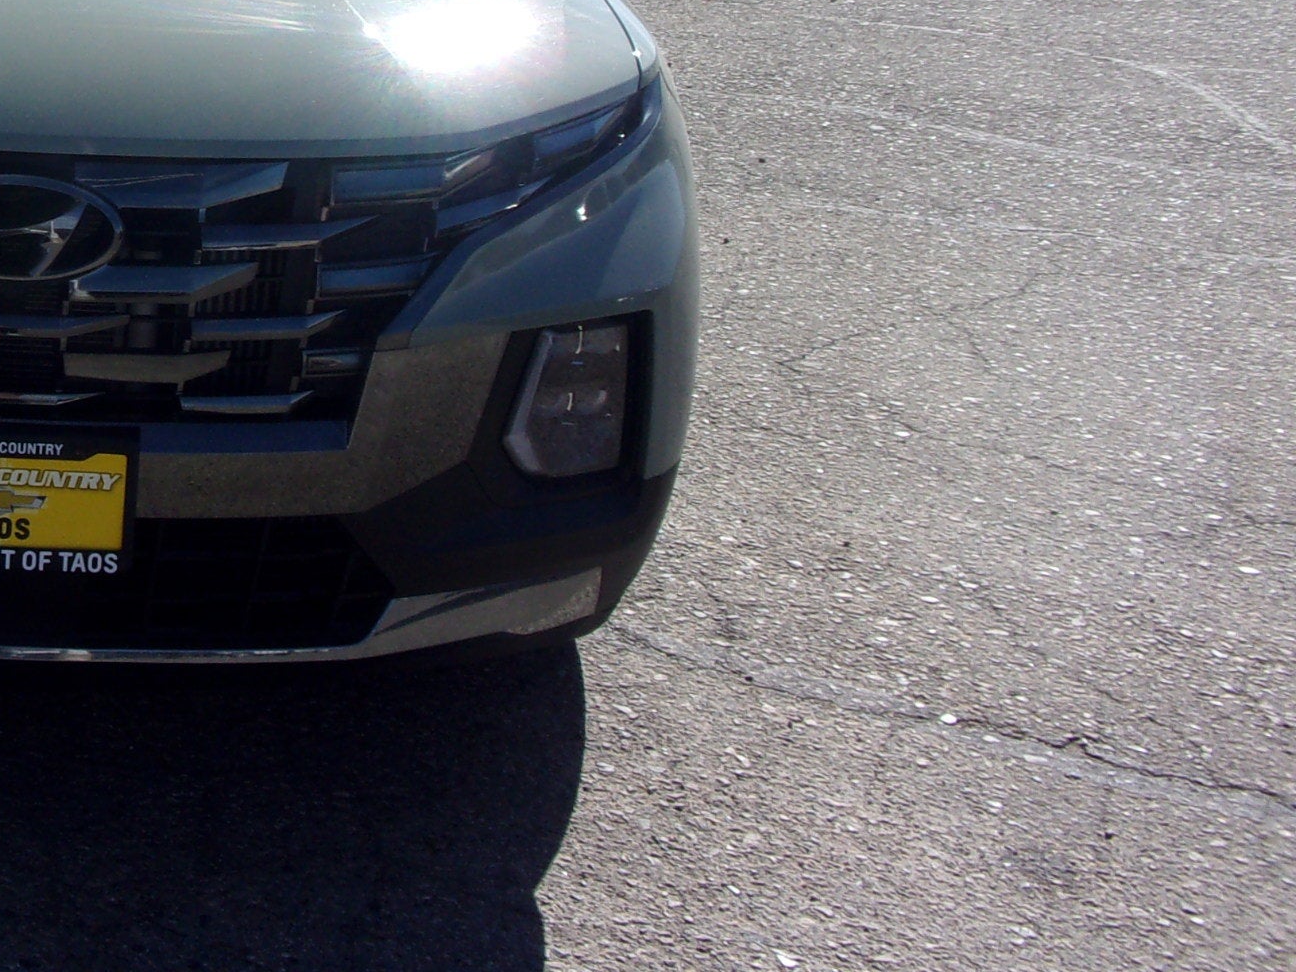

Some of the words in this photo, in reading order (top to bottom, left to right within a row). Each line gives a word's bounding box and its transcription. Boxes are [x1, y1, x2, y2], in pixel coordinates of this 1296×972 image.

[0, 442, 64, 456] COUNTRY
[21, 550, 53, 571] OF
[58, 551, 119, 574] TAOS
